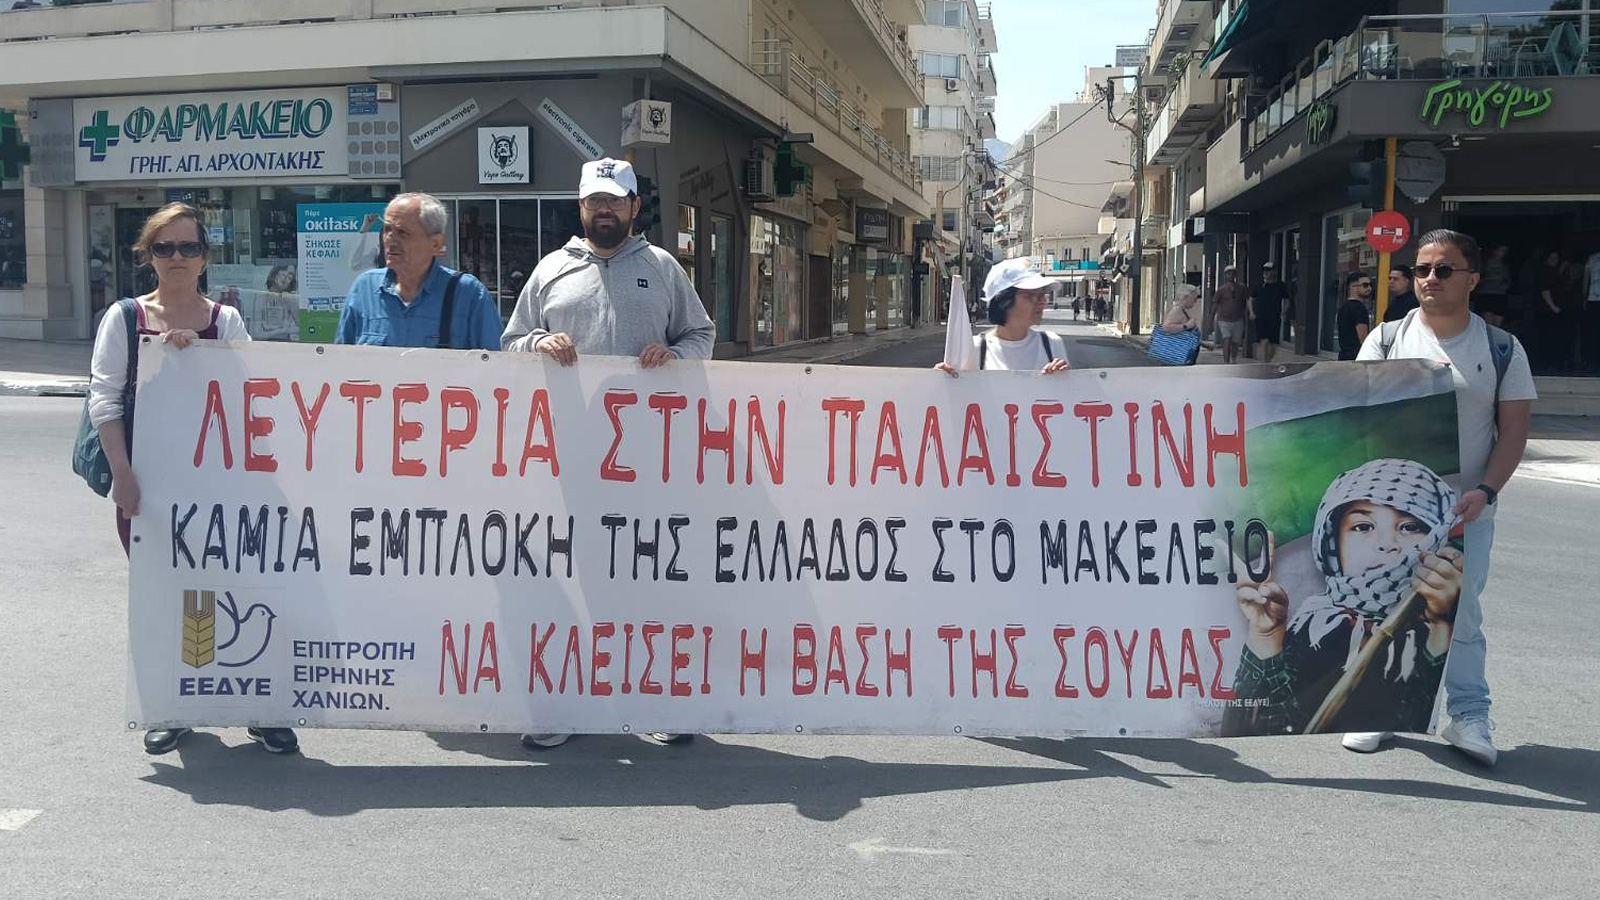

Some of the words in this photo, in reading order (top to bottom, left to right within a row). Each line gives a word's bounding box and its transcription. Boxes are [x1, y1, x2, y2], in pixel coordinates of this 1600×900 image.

[1422, 80, 1553, 128] Γρηγόρης
[123, 98, 333, 143] ΦΑΡΜΑΚΕΙΟ
[543, 103, 573, 132] electronic
[572, 131, 599, 158] cigarette
[130, 155, 172, 174] ΓΡΗΓ.
[176, 154, 203, 173] ΑΠ.
[206, 150, 326, 172] ΑΡΧΟΝΤΑΚΗΣ
[305, 239, 342, 249] ΣΗΚΩΣΕ
[306, 249, 341, 259] ΚΕΦΑΛΙ
[194, 378, 560, 478] ΛΕΥΤΕΡΙΑ
[600, 388, 787, 486] ΣΤΗΝ
[821, 397, 1248, 488] ΠΑΛΑΙΣΤΙΝΗ
[171, 503, 321, 574] ΚΑΜΙΑ
[349, 507, 575, 579] ΕΜΠΛΟΚΗ
[601, 514, 690, 582] ΤΗΣ
[715, 516, 908, 584] ΕΛΛΑΔΟΣ
[932, 517, 1016, 583] ΣΤΟ
[1039, 517, 1272, 585] ΜΑΚΕΛΕΙΟ
[293, 640, 415, 660] ΕΠΙΤΡΟΠΗ
[439, 620, 501, 695] ΝΑ
[528, 621, 714, 696] ΚΛΕΙΣΕΙ
[740, 628, 768, 696] Η
[792, 622, 912, 698] ΒΑΣΗ
[937, 624, 1029, 698] ΤΗΣ
[1053, 624, 1237, 699] ΣΟΥΔΑΣ
[180, 677, 271, 696] ΕΕΔΥΕ
[293, 664, 395, 686] ΕΙΡΗΝΗΣ
[292, 690, 390, 710] ΧΑΝΙΩΝ.
